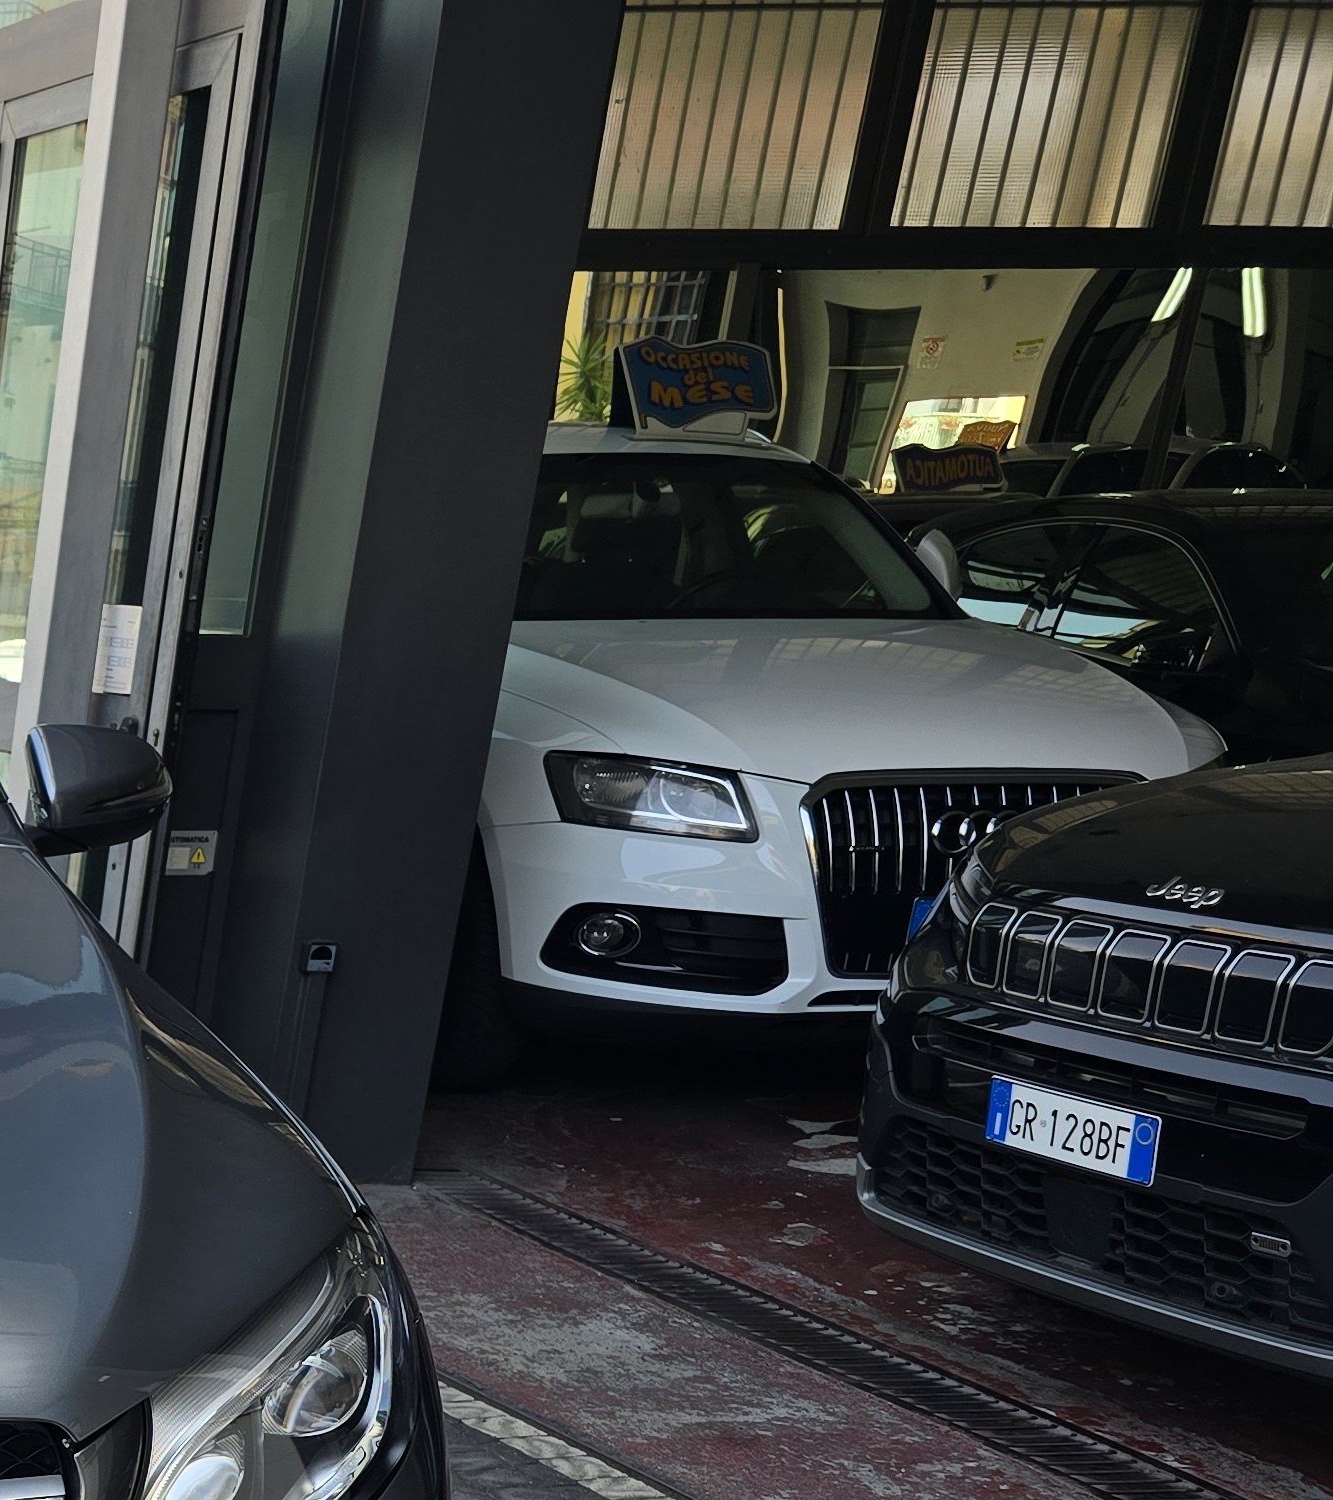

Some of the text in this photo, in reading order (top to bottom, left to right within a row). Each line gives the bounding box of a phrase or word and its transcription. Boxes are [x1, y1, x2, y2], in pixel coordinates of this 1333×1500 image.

[639, 345, 750, 371] OCCASIONE
[684, 366, 715, 386] del
[650, 380, 754, 409] MESE
[1145, 875, 1226, 909] Jeep
[1008, 1099, 1038, 1142] GR
[1049, 1109, 1131, 1164] 128BF
